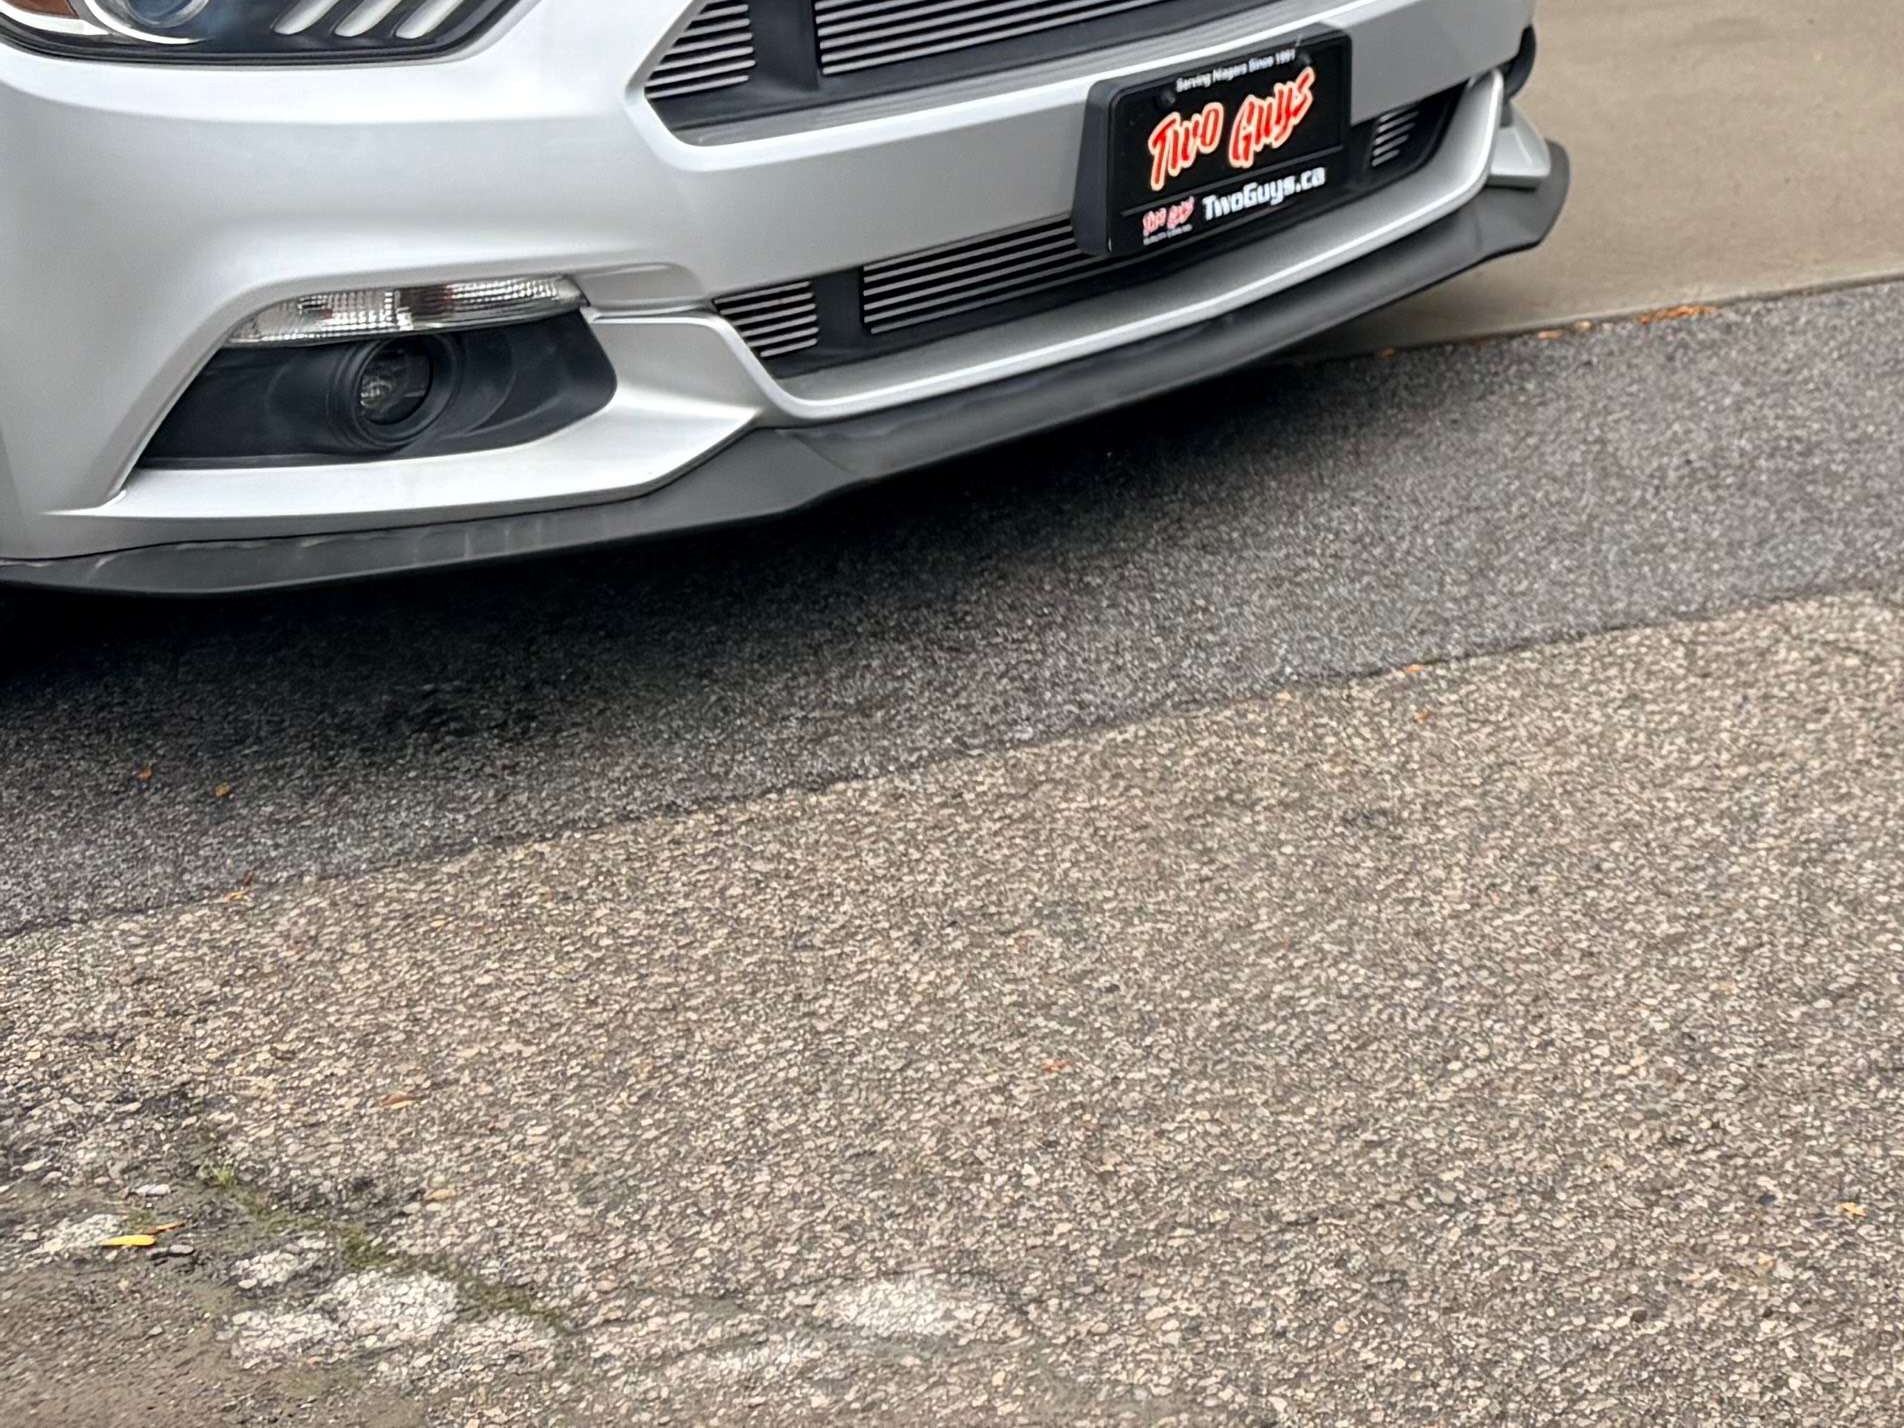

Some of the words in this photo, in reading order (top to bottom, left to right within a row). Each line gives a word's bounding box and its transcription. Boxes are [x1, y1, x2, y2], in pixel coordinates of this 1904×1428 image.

[1148, 102, 1224, 191] Two
[1229, 66, 1315, 168] Guys
[1202, 166, 1326, 220] TwoGuys.ca
